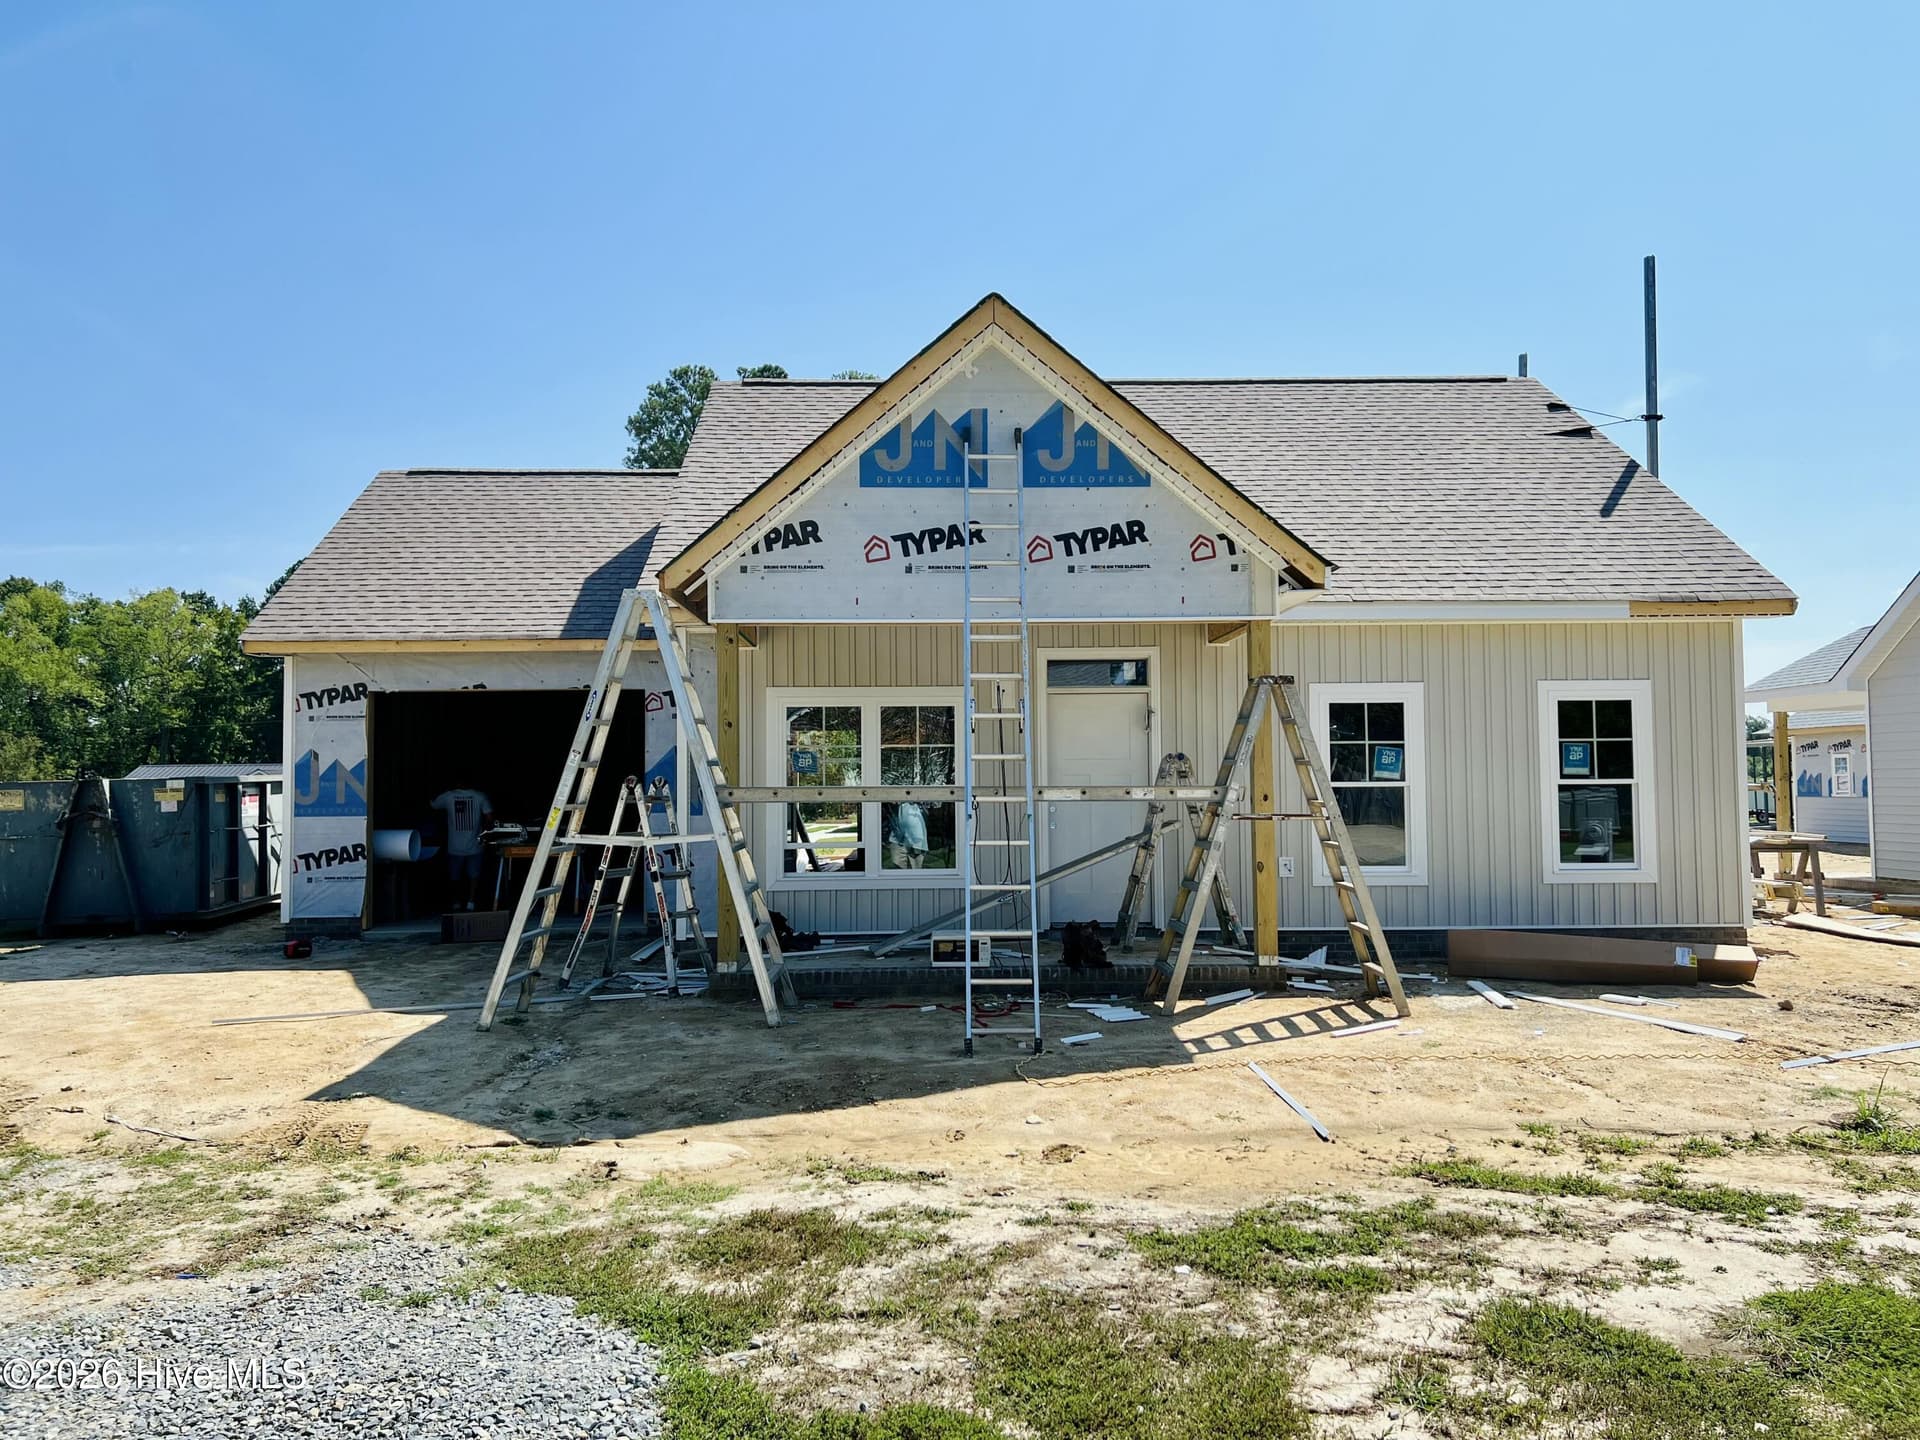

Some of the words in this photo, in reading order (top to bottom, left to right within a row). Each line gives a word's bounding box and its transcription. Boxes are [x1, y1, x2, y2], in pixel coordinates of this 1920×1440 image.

[876, 475, 961, 484] DEVELOPER
[1039, 475, 1134, 483] DEVELOPERS
[740, 520, 823, 557] PAR
[890, 520, 987, 558] TYPAR
[1053, 520, 1149, 557] TYPAR
[299, 682, 368, 710] TYPAR
[296, 843, 367, 871] TYPAR
